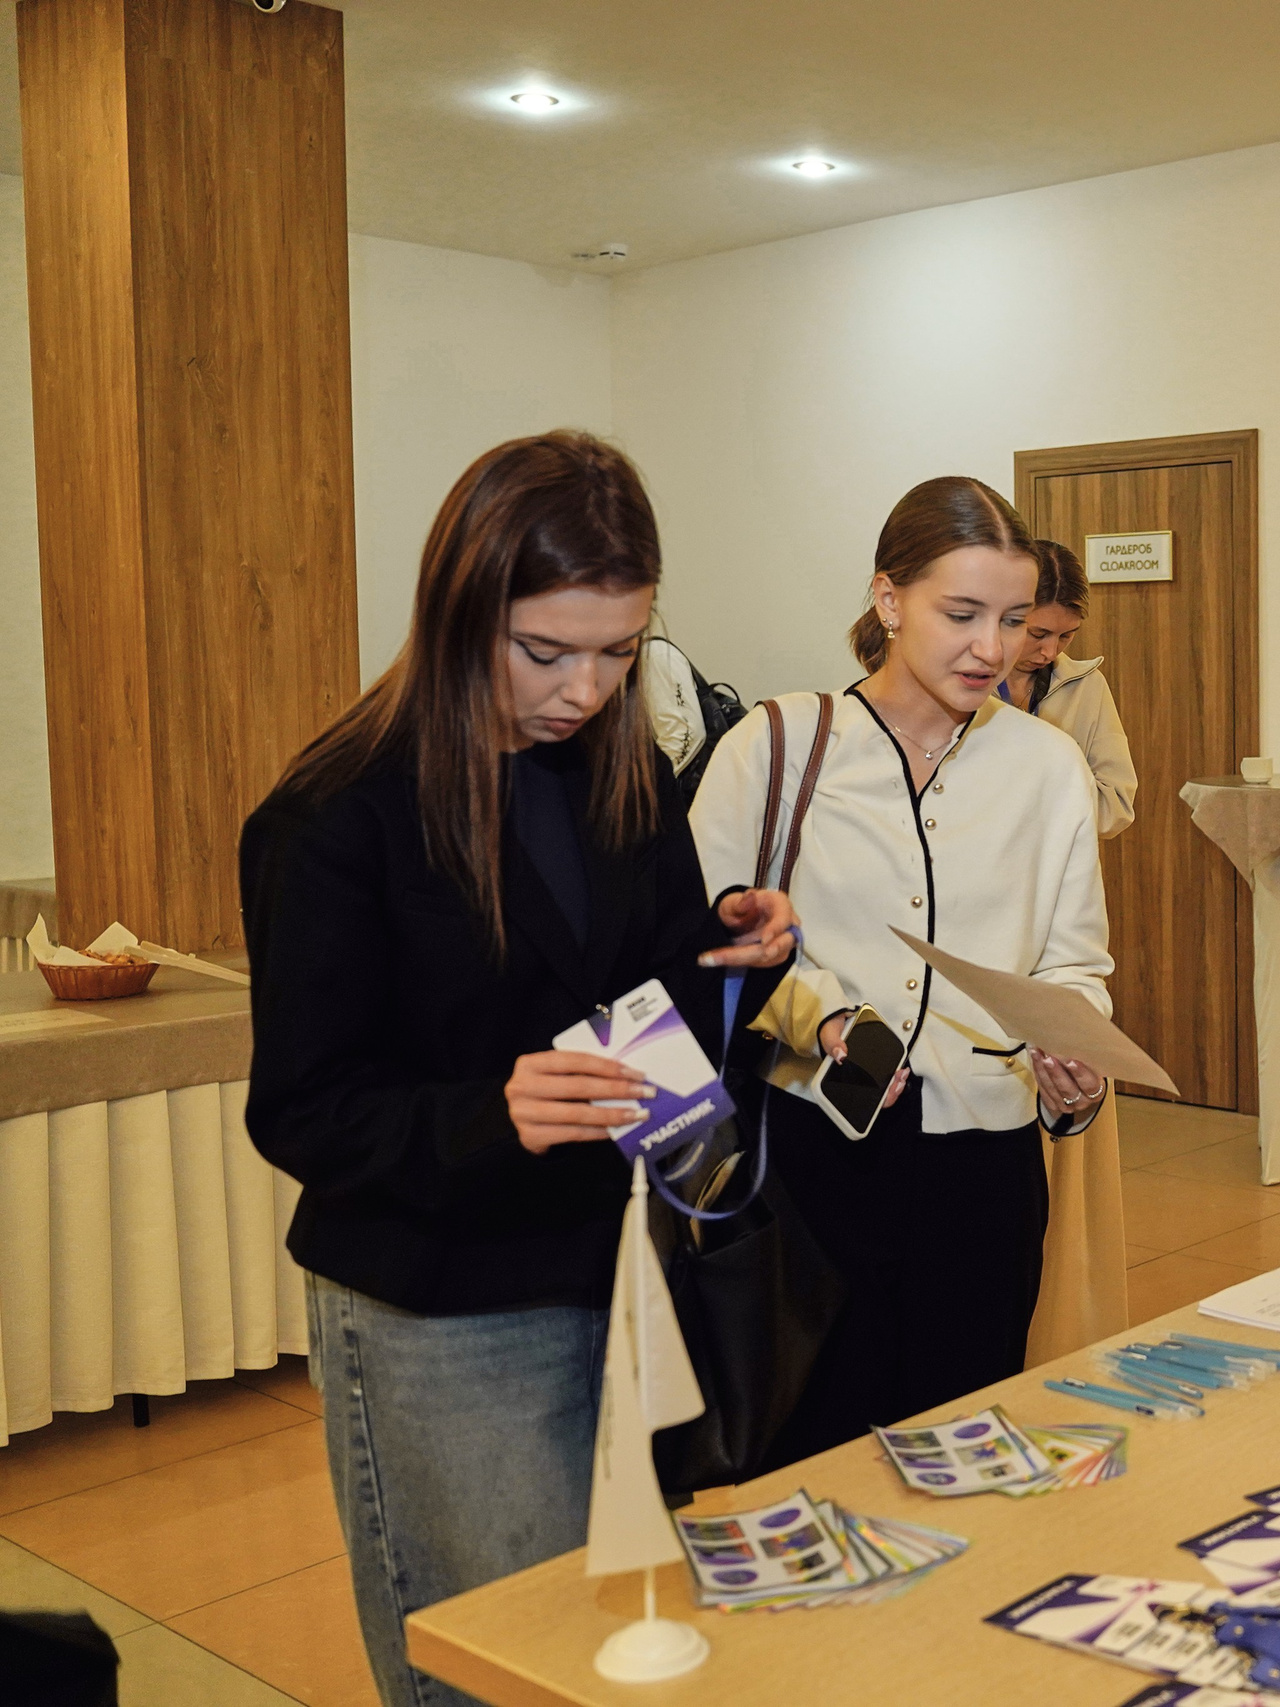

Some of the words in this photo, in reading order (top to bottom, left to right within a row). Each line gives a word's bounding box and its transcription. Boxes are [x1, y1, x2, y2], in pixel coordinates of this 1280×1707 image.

[1105, 543, 1153, 556] ГАРДЕРОБ
[1099, 559, 1159, 572] CLOAKROOM
[639, 1098, 717, 1152] УЧАСТНИК
